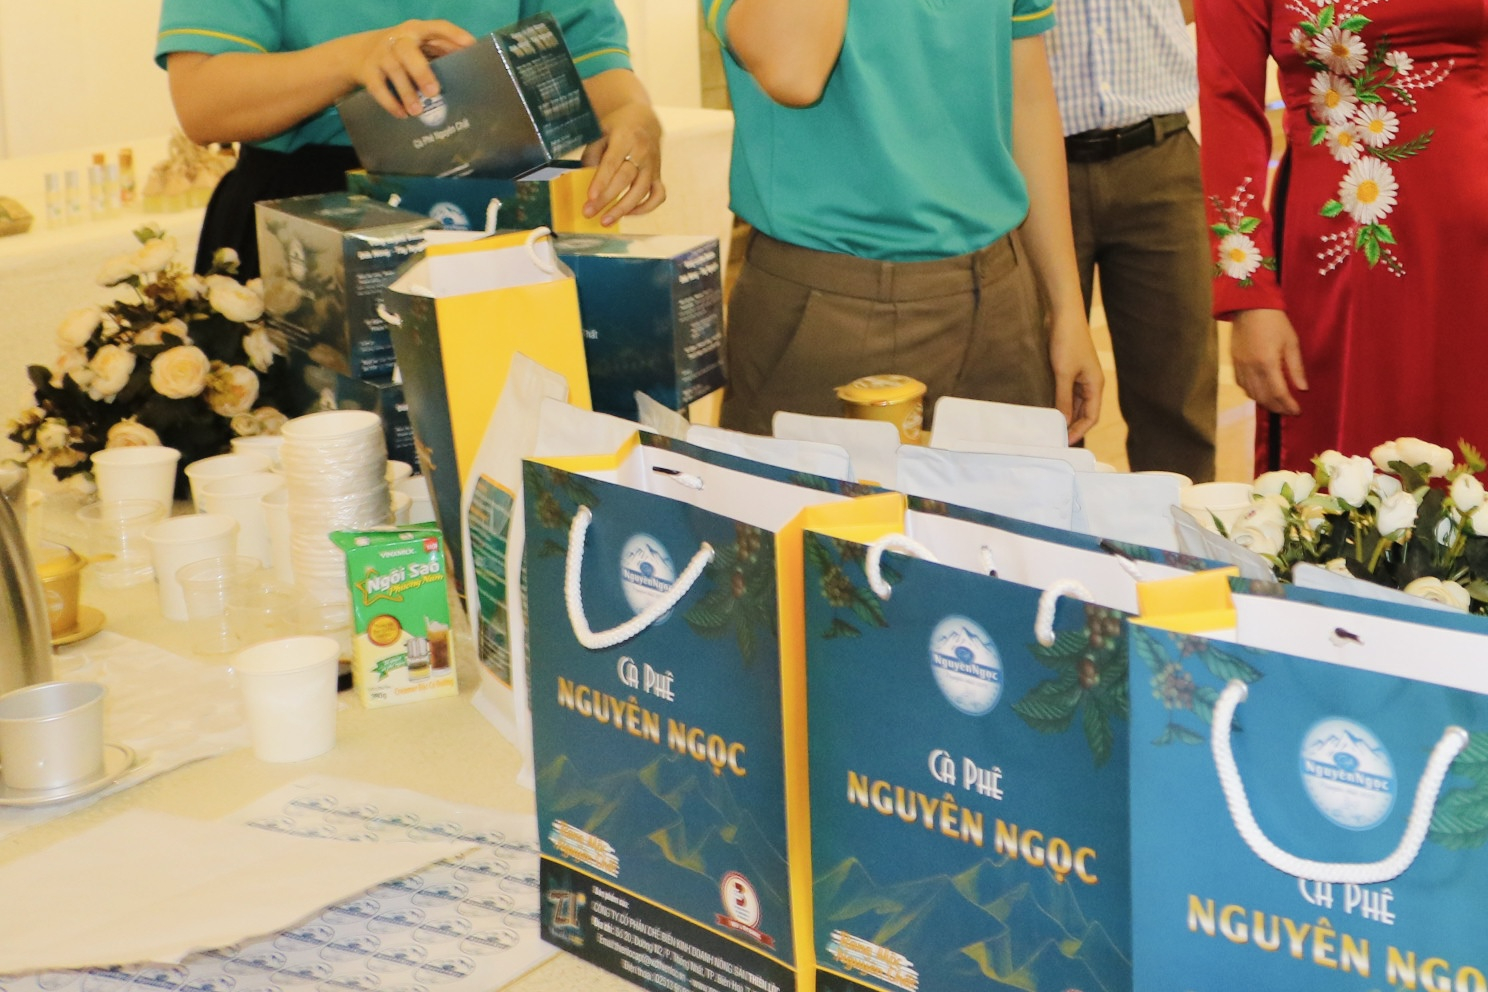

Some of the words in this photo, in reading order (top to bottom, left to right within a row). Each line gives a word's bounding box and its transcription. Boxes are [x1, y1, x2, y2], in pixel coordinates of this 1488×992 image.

[367, 567, 406, 594] Ngôi
[408, 561, 440, 579] Sao
[624, 569, 672, 593] NguyênNgọ
[643, 663, 675, 702] PHÊ
[557, 675, 661, 745] NGUYÊN
[667, 717, 747, 777] NGỌC
[963, 757, 1004, 800] PHÊ
[847, 770, 984, 847] NGUYÊN
[994, 818, 1098, 885] NGỌC
[1187, 894, 1371, 978] NGUYÊN
